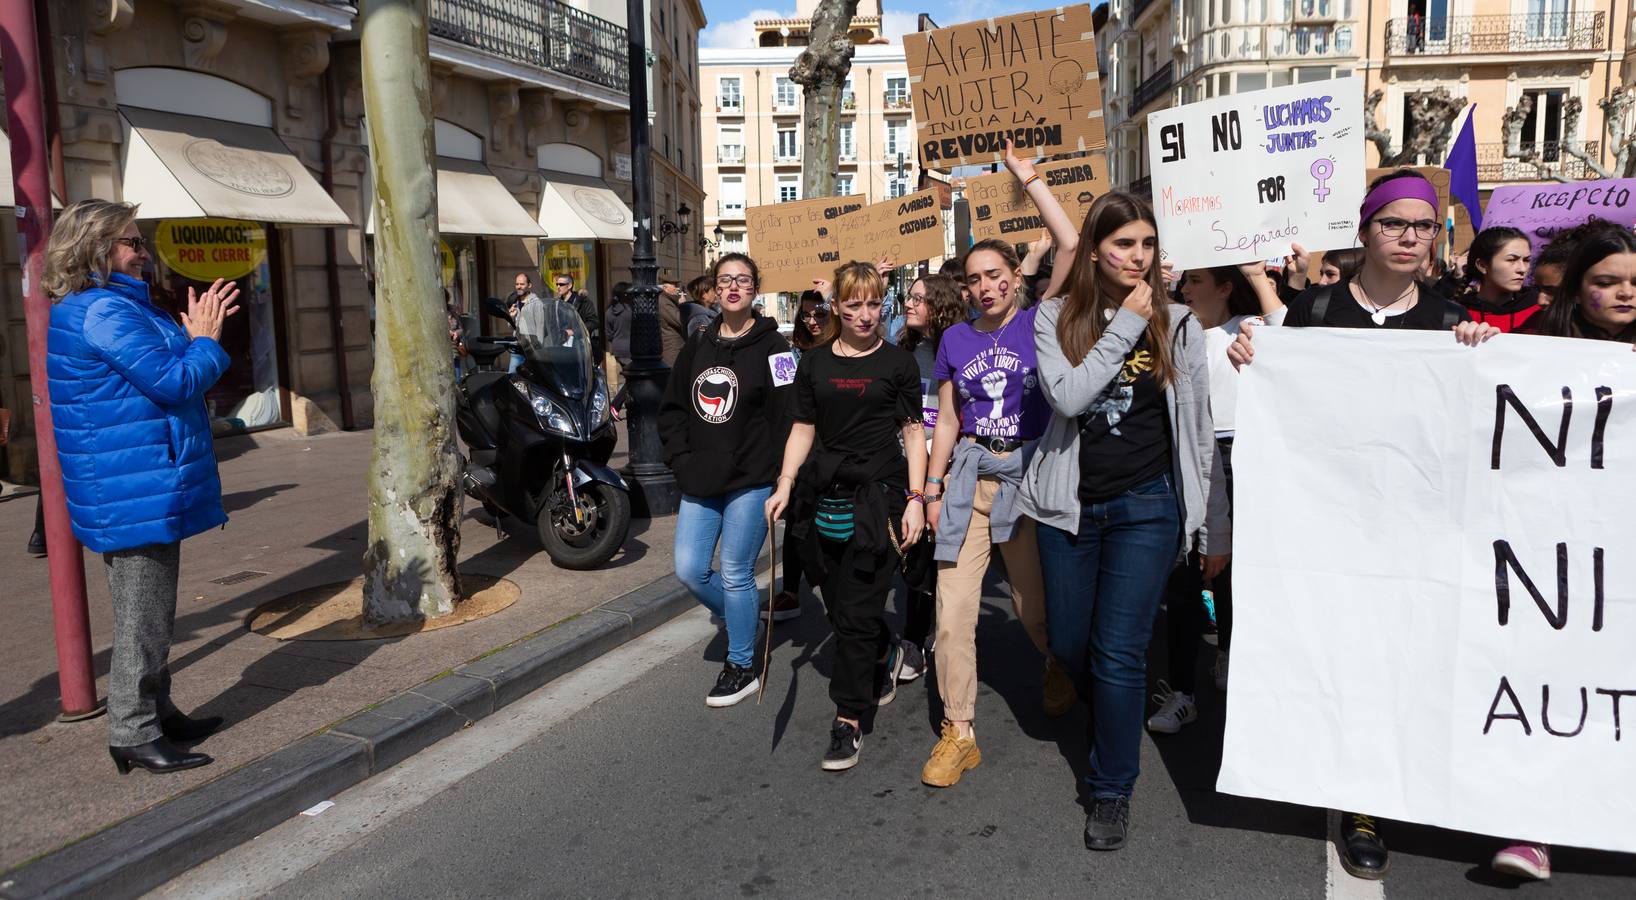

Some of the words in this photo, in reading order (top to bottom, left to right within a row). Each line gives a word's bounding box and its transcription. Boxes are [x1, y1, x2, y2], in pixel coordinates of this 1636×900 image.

[922, 71, 1043, 121] MUJER,
[928, 114, 1001, 136] INICIA
[1012, 110, 1035, 125] LA
[923, 117, 1063, 162] REVOLUCIÓN
[1160, 122, 1187, 163] SI
[1211, 110, 1242, 152] NO
[1265, 130, 1317, 154] JUNTAS
[970, 181, 998, 201] Para
[1256, 175, 1286, 204] POR
[975, 204, 992, 219] NO
[171, 224, 254, 244] LIQUIDACIÓN
[1211, 217, 1299, 256] Separado
[178, 248, 206, 263] POR
[212, 248, 251, 262] CIERRE
[988, 347, 1008, 356] MRZO
[703, 414, 727, 423] AKTION
[1009, 413, 1021, 424] LA
[1491, 384, 1612, 470] NI
[1492, 539, 1604, 632] NI
